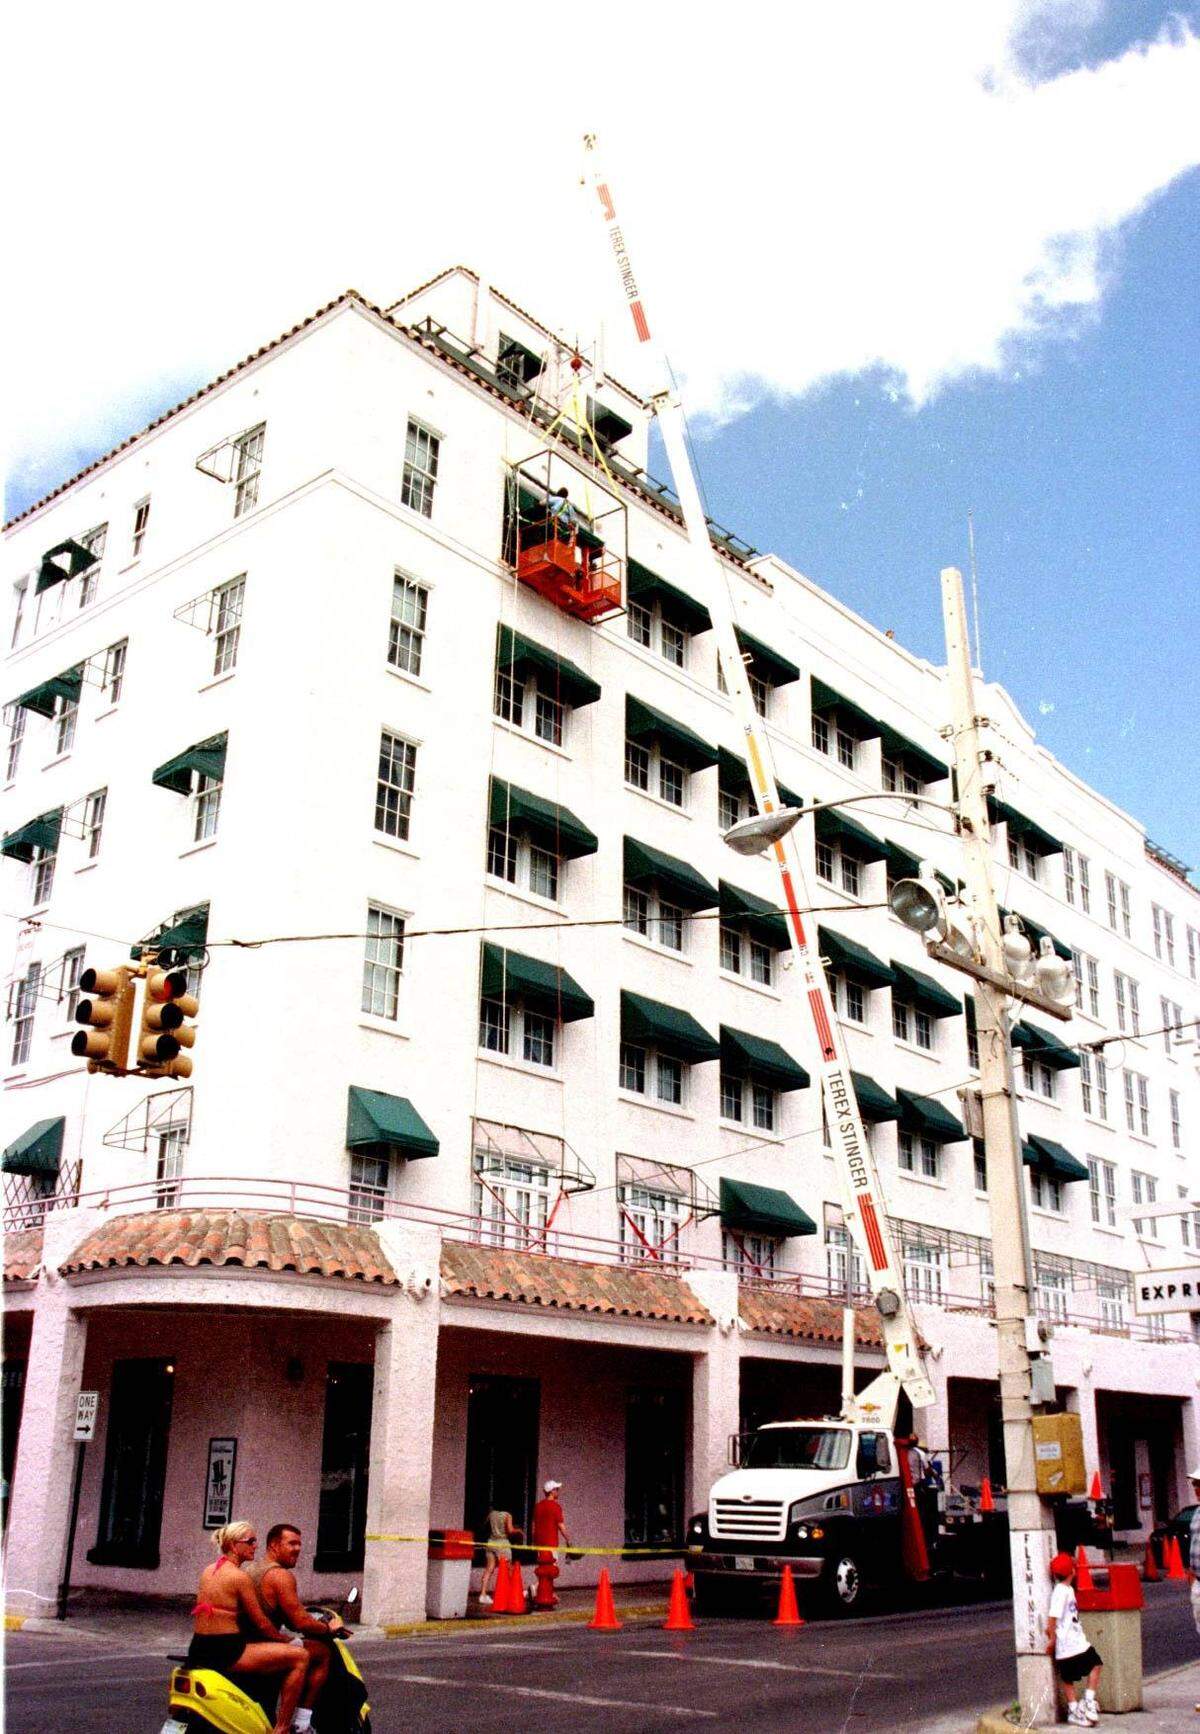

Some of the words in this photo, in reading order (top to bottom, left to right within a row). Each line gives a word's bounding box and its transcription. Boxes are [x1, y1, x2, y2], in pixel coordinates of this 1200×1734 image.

[609, 225, 626, 256] TEREX
[617, 256, 638, 299] STINGER
[827, 1070, 851, 1118] TEREX
[839, 1122, 868, 1189] STINGER
[78, 1410, 95, 1421] WAY
[79, 1396, 95, 1407] ONE
